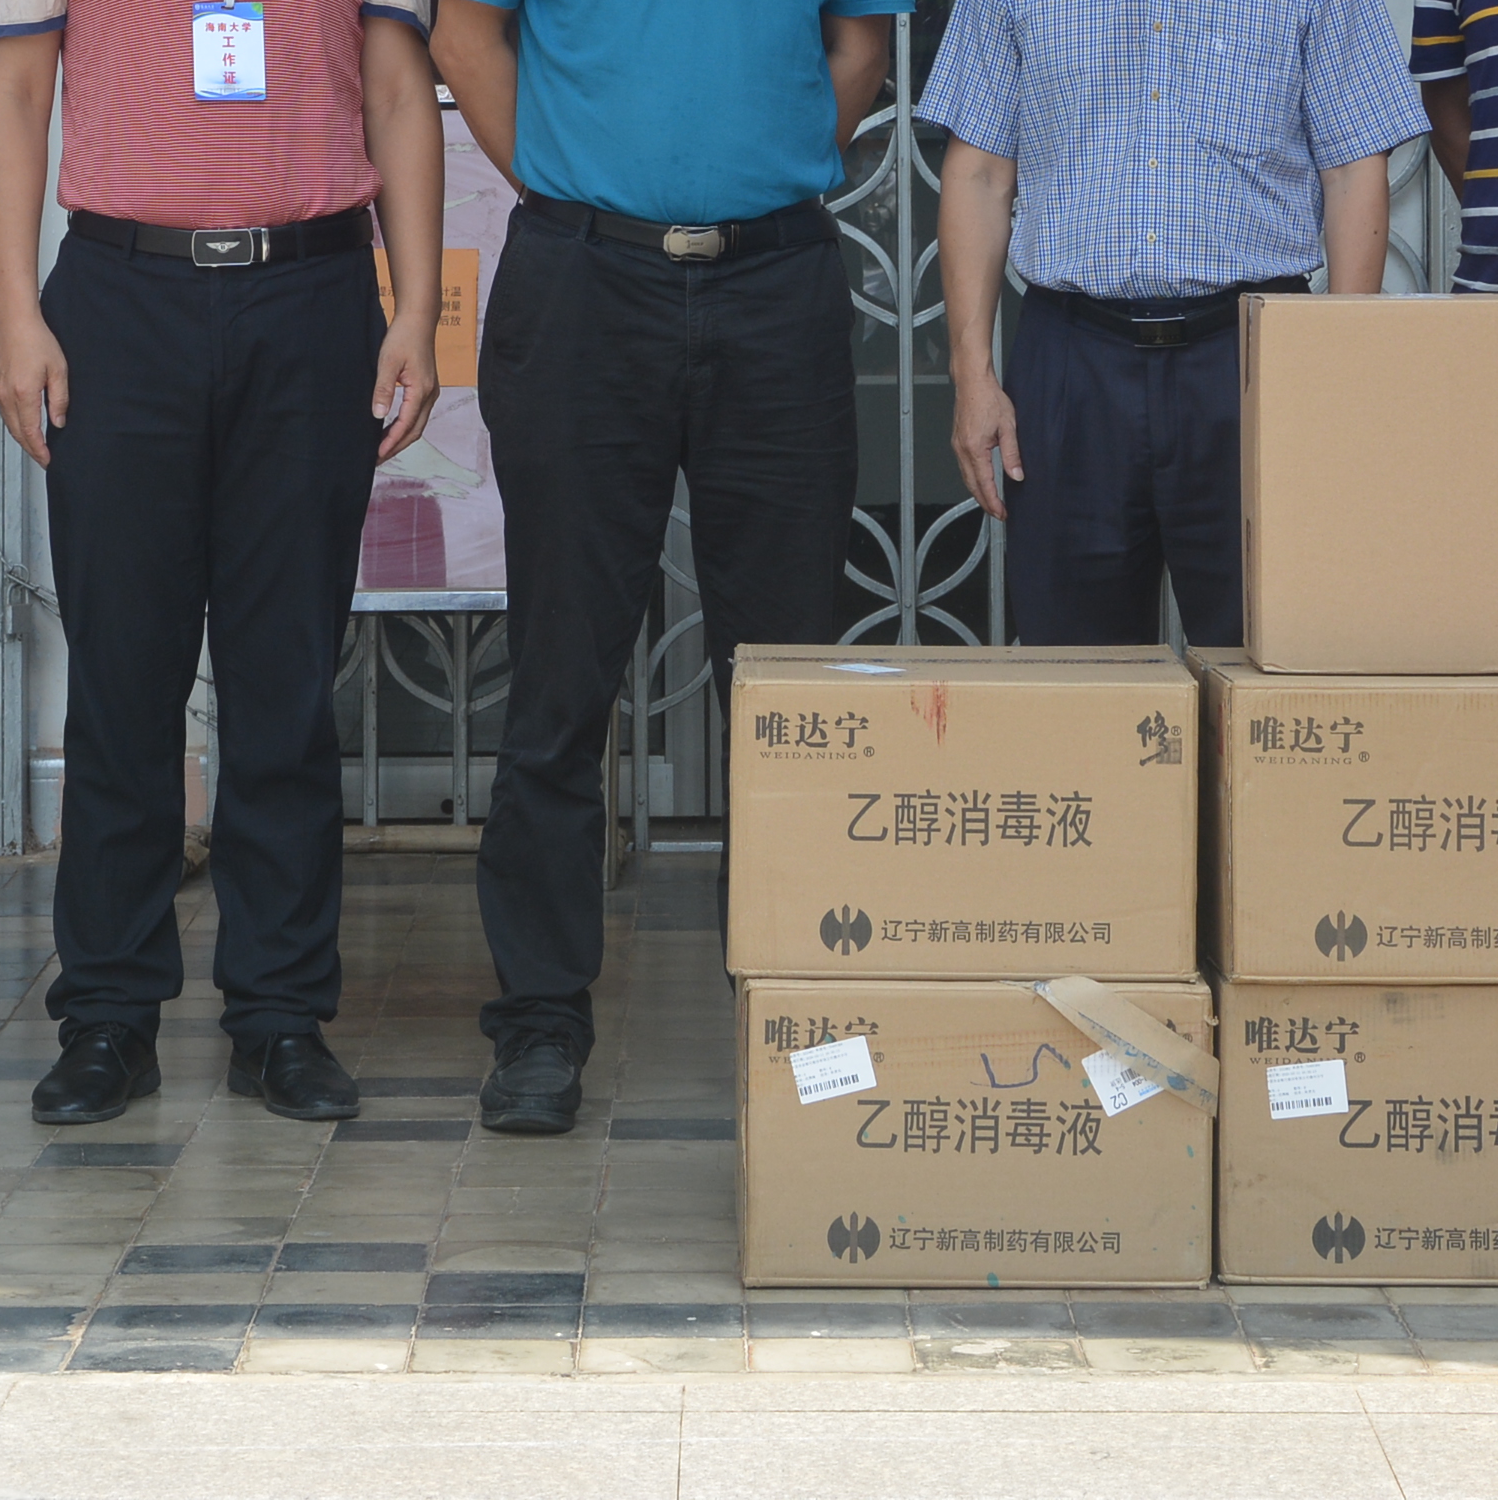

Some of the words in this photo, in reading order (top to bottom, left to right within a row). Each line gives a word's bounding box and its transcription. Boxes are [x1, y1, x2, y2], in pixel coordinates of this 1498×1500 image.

[205, 22, 251, 33] 海南大学
[222, 36, 236, 84] 工作证
[755, 711, 868, 749] 唯达宁
[1250, 716, 1364, 754] 唯达宁
[759, 752, 856, 760] WEIDANING
[1255, 756, 1352, 765] WEIDANING
[847, 789, 1093, 848] 乙醇消毒液
[881, 919, 1112, 945] 辽宁新高制药有限公司
[1244, 1016, 1359, 1054] 唯达宁
[1250, 1057, 1348, 1065] WEIDAN
[856, 1096, 1102, 1156] 乙醇消毒液
[889, 1227, 1121, 1255] 辽宁新高制药有限公司
